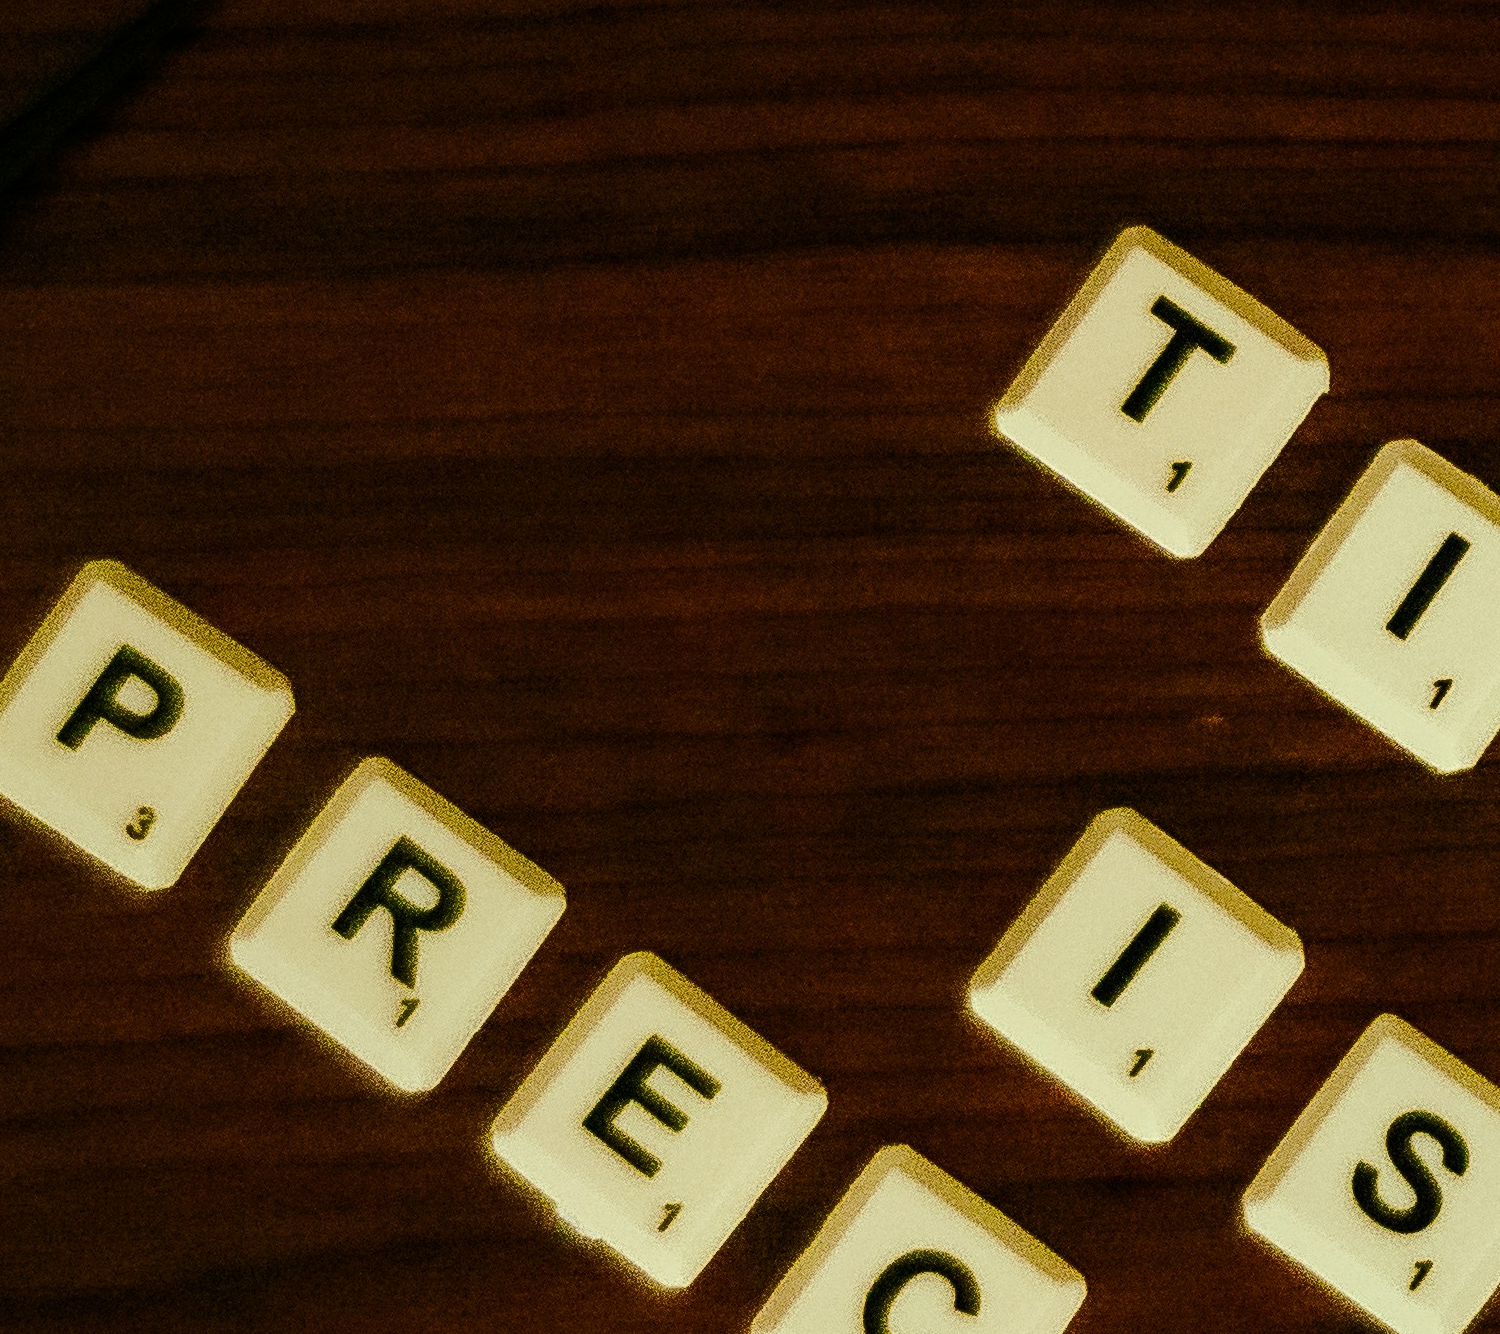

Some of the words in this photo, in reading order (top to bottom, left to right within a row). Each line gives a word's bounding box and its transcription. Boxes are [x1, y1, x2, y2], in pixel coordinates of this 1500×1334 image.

[1167, 462, 1191, 492] 1
[1430, 679, 1452, 709] 1
[396, 998, 419, 1027] 1
[1090, 904, 1469, 1236] IS
[1129, 1049, 1153, 1077] 1
[658, 1204, 681, 1232] 1
[1409, 1261, 1432, 1290] 1
